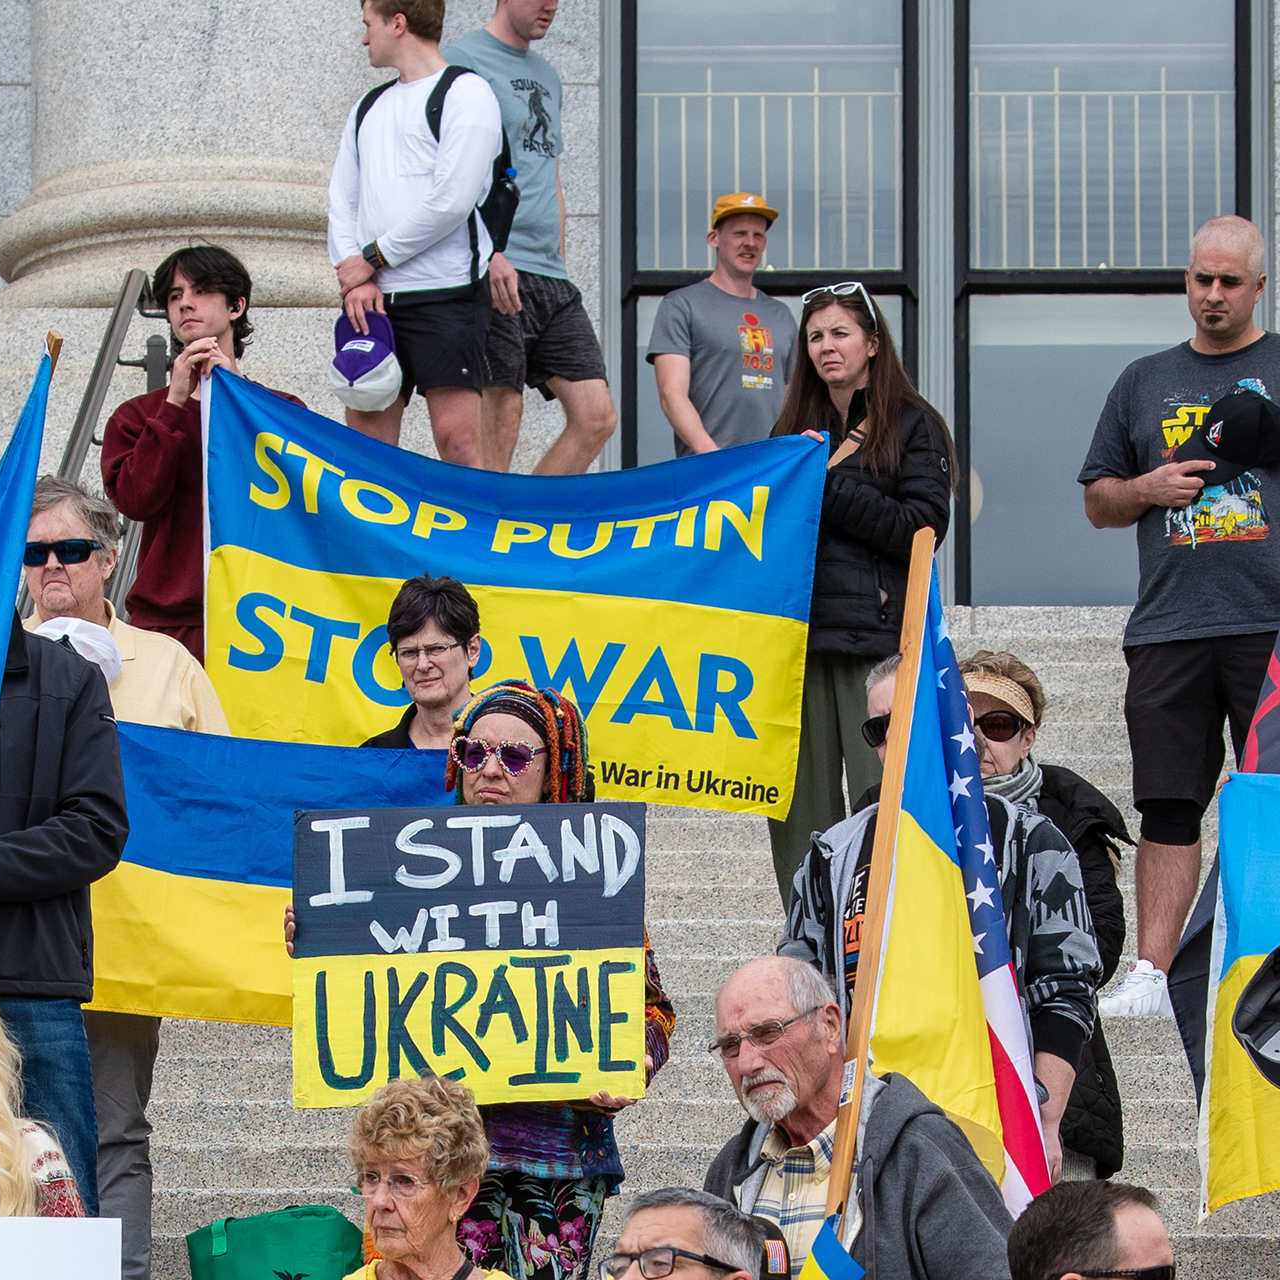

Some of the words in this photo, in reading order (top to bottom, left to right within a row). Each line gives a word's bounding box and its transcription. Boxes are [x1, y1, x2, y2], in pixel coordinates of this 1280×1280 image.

[742, 353, 774, 371] 70.3
[1162, 407, 1211, 427] ST
[249, 431, 468, 540] STOP
[491, 485, 769, 561] PUTIN
[519, 635, 758, 740] WAR
[601, 761, 652, 788] War
[656, 765, 680, 790] in
[686, 770, 780, 804] Ukraine
[309, 816, 375, 907] I
[394, 812, 642, 898] STAND
[369, 899, 560, 954] WITH
[315, 954, 637, 1090] UKRAINE
